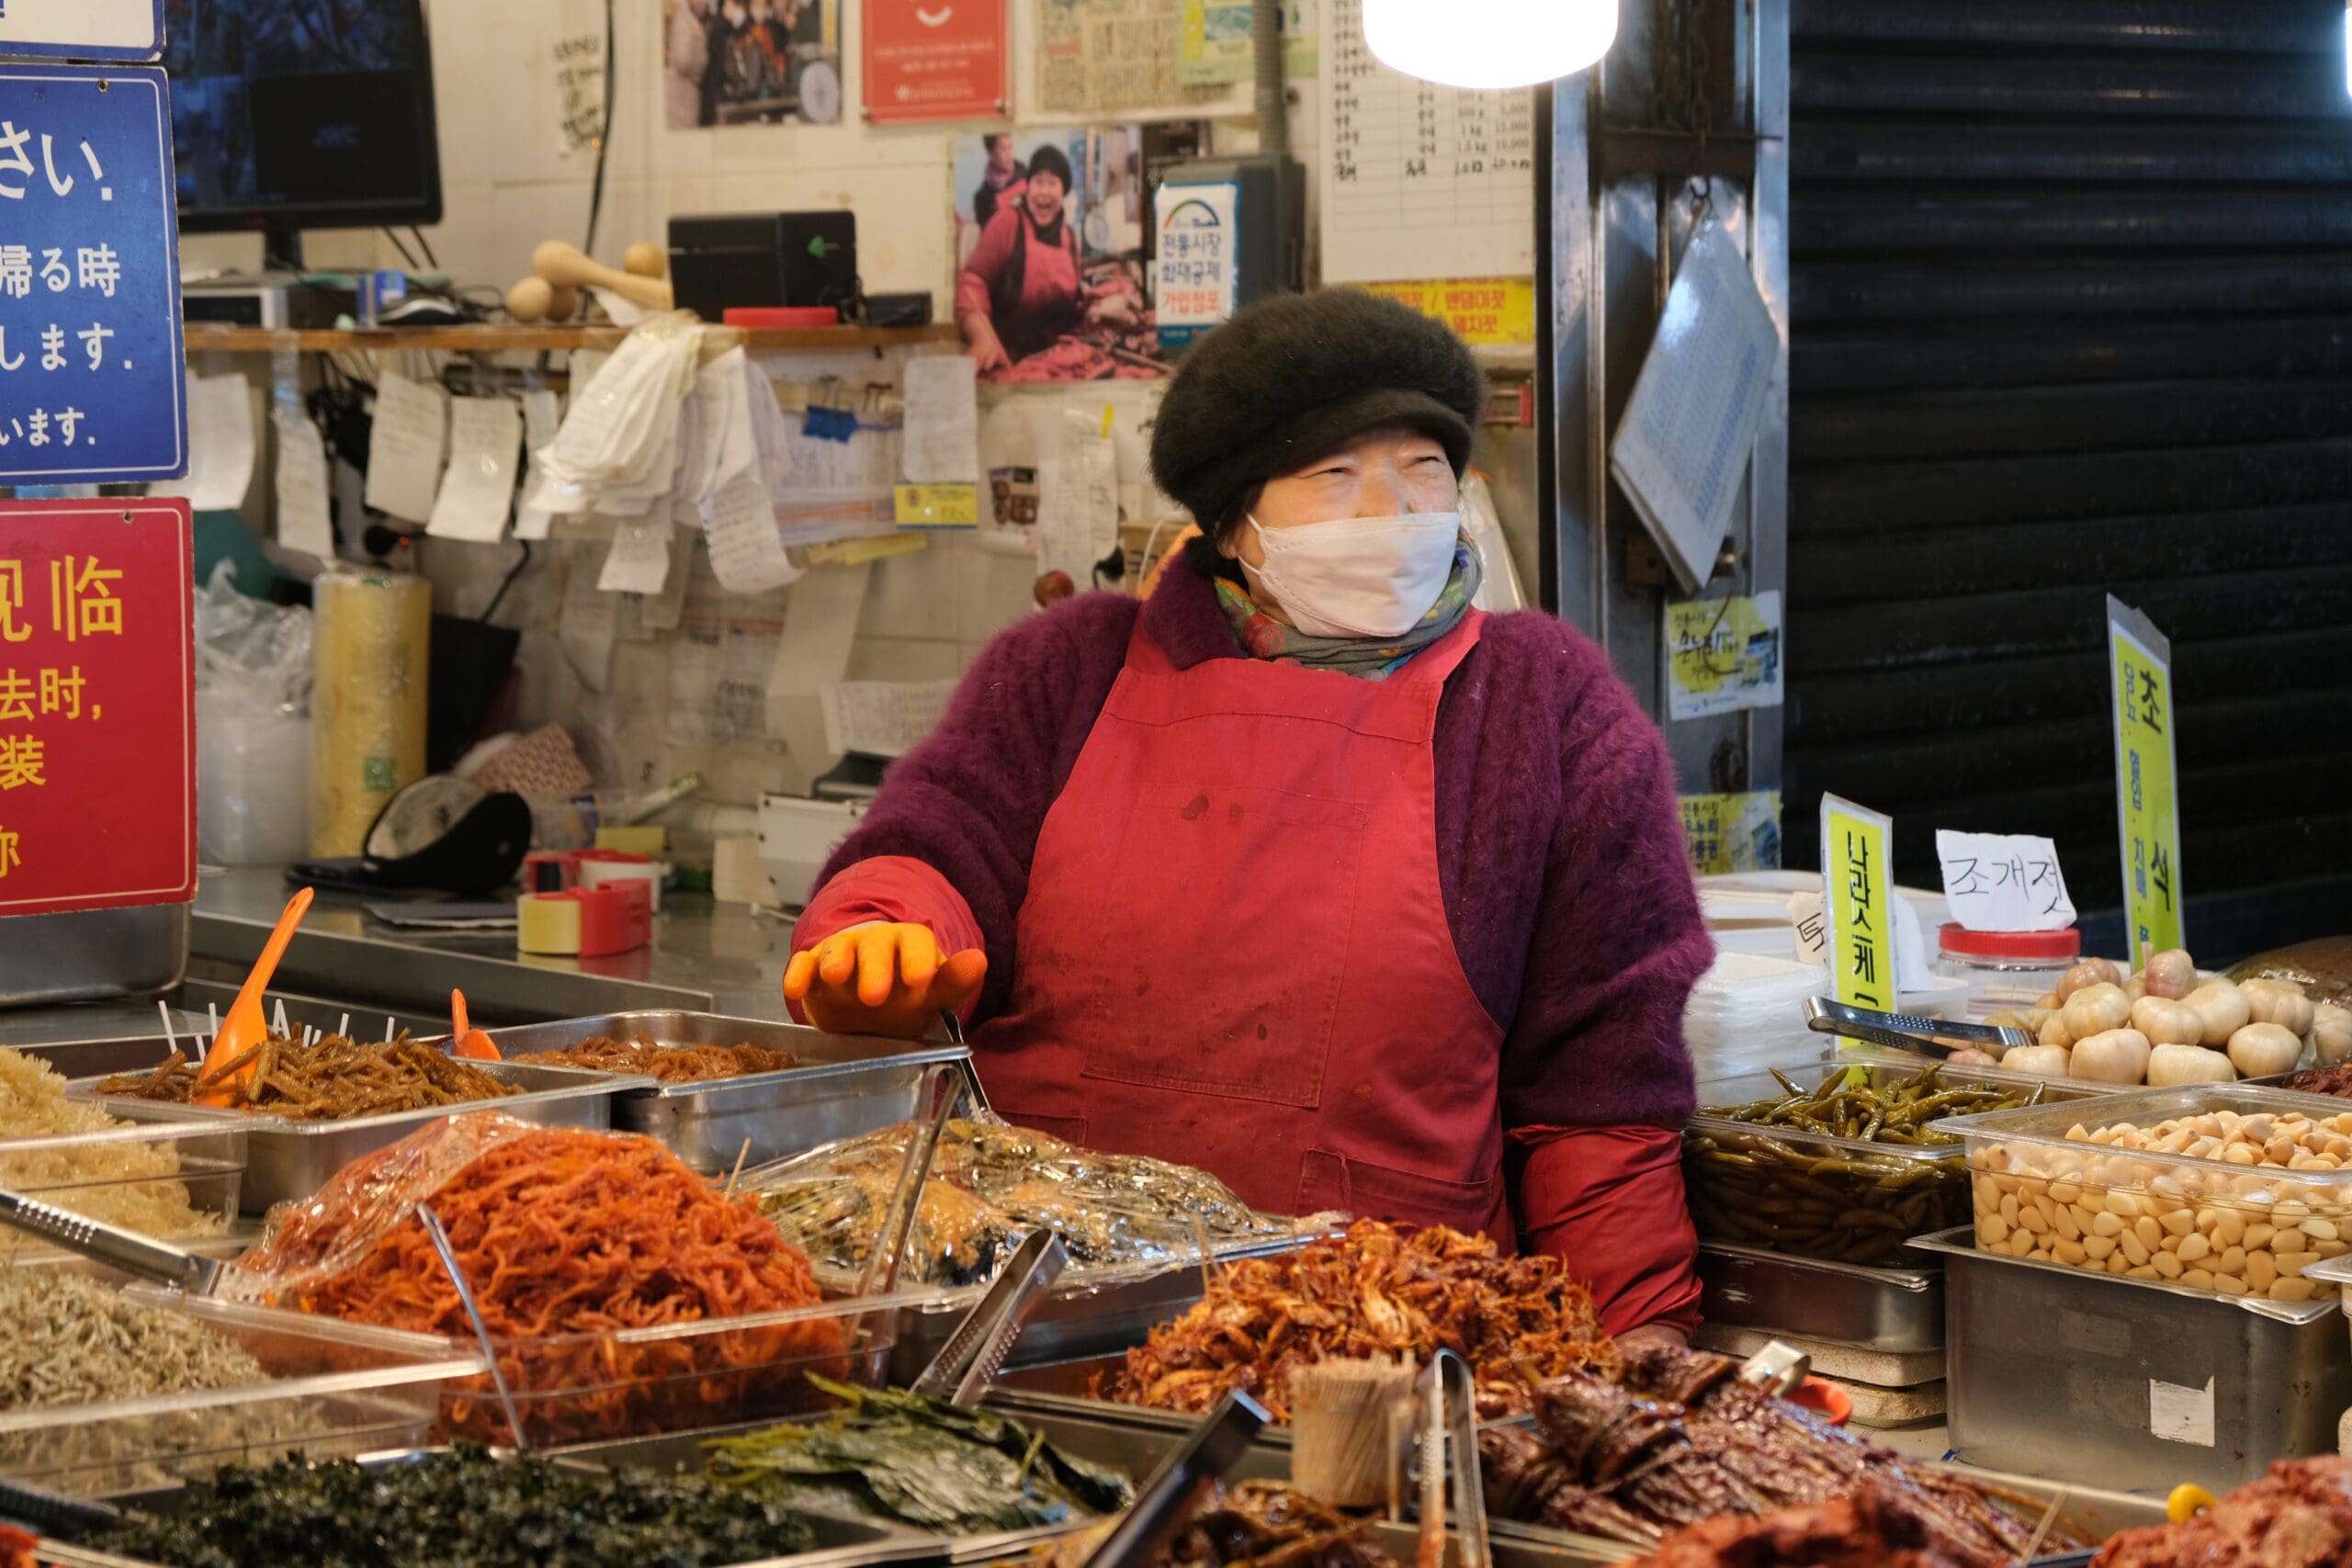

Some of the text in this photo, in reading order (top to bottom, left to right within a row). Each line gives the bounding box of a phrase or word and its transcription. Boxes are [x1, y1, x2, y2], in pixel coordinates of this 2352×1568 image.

[0, 243, 120, 299] 帰る時
[1162, 233, 1221, 258] 전통시장
[1162, 261, 1221, 286] 화재공제
[0, 734, 47, 790] 装
[1947, 853, 2071, 915] 조개젓
